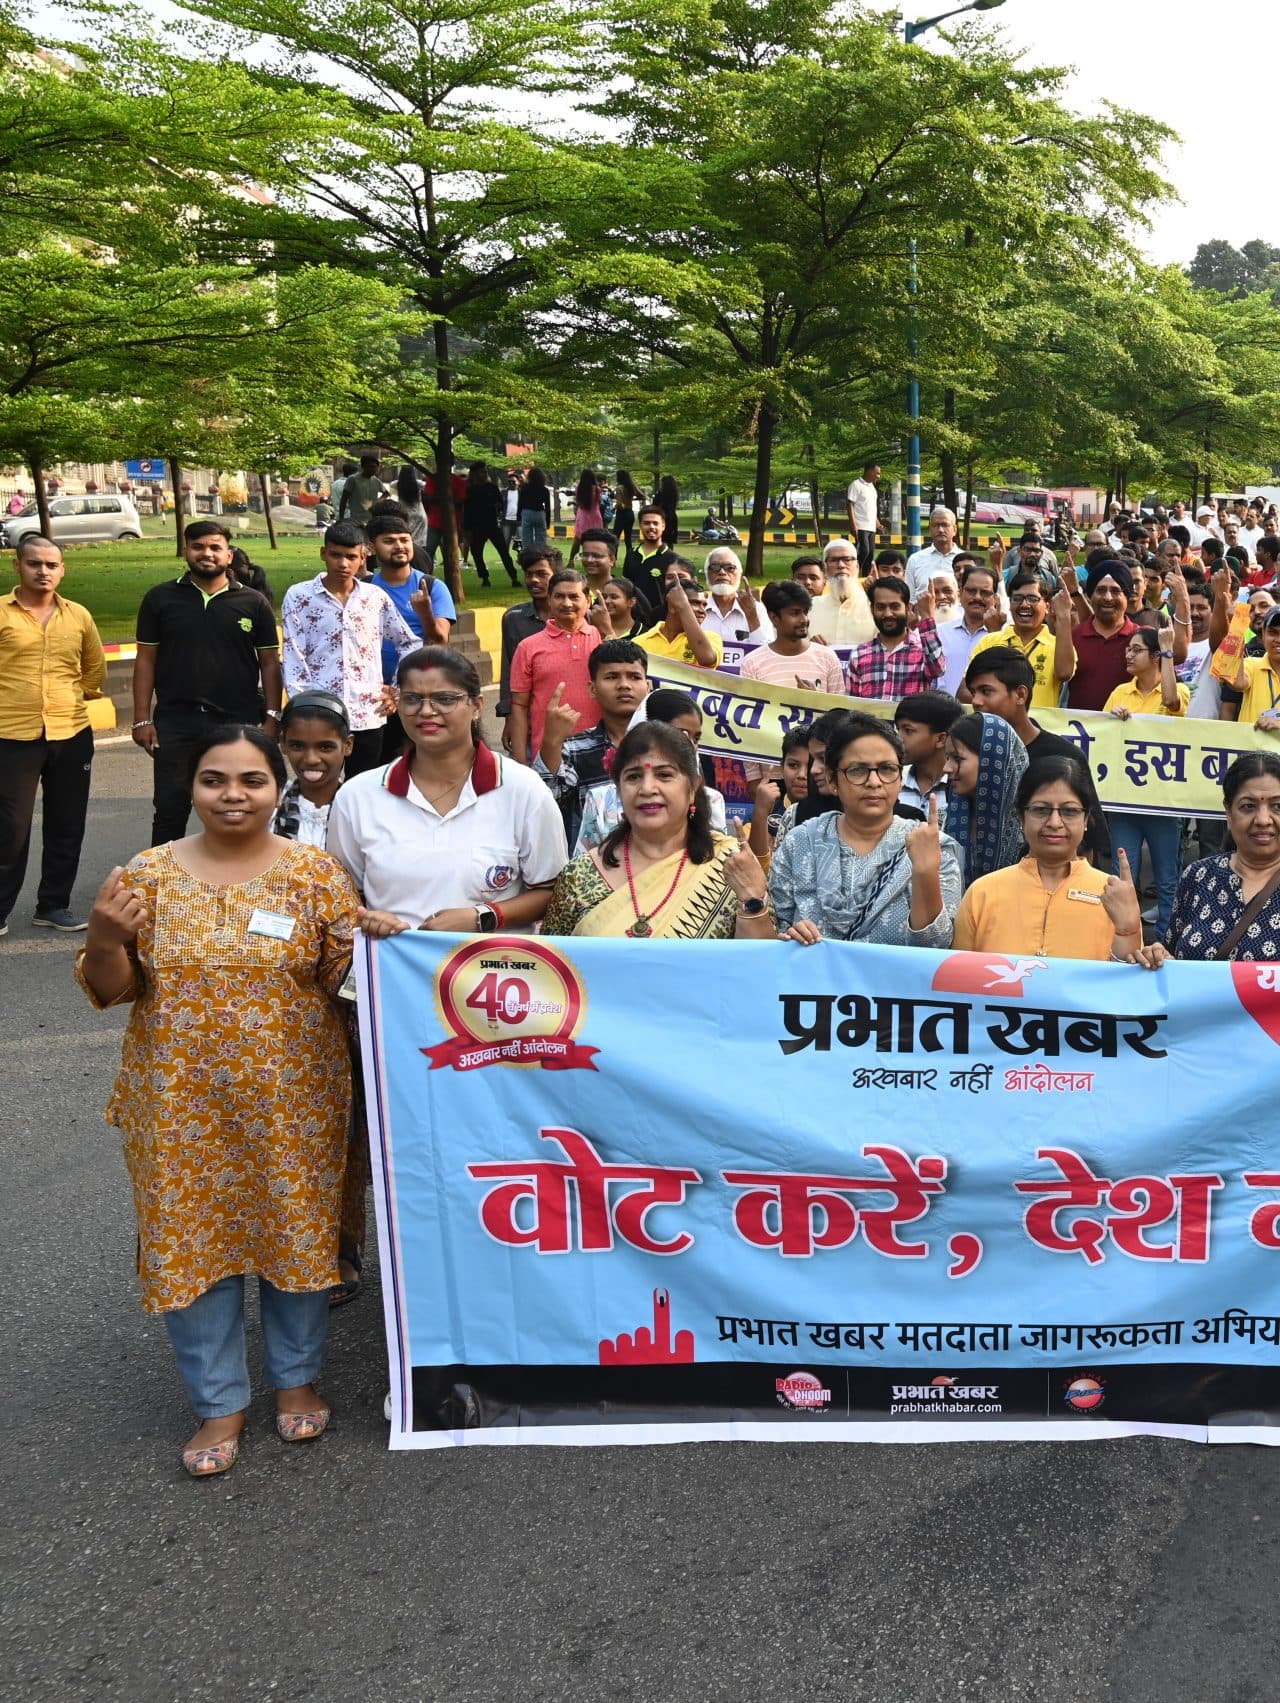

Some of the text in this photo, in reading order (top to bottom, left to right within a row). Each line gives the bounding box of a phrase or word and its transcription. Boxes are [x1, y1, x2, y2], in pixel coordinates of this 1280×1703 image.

[1124, 739, 1191, 786] इस
[480, 959, 537, 970] प्रभात खबर
[778, 992, 1168, 1058] प्रभात खबर
[458, 1038, 567, 1067] अखबार नहीं आंदोलन
[853, 1063, 1094, 1093] अखबार नहीं आंदोलन
[466, 1126, 703, 1256] वोट
[721, 1142, 985, 1280] करें,
[1014, 1146, 1226, 1267] देश
[718, 1314, 799, 1349] प्रभात
[809, 1321, 887, 1350] खबर
[899, 1322, 1011, 1354] मतदाता
[1020, 1320, 1185, 1351] जागरूकता
[776, 1378, 813, 1391] RADIO
[891, 1384, 1000, 1401] प्रभात खबर
[890, 1402, 1002, 1415] prabhatkhabar.com
